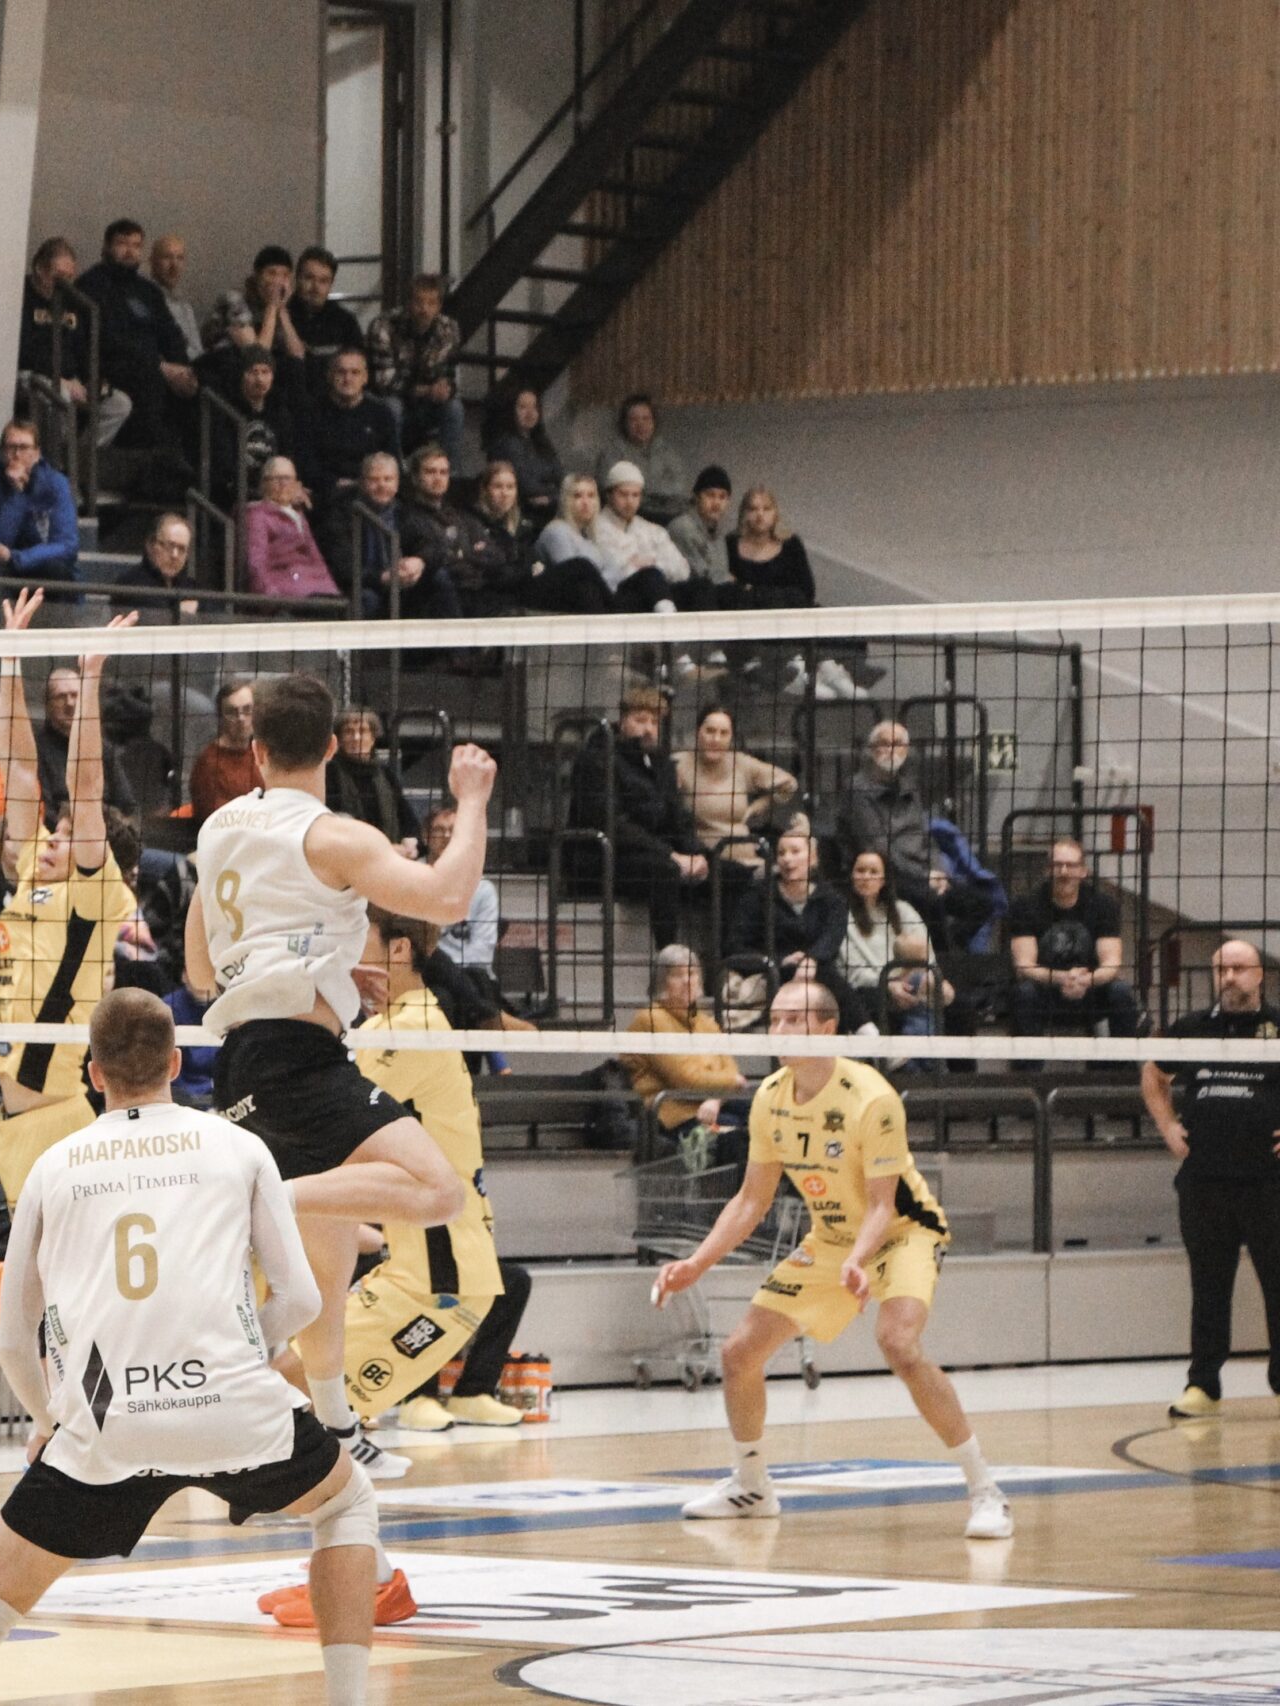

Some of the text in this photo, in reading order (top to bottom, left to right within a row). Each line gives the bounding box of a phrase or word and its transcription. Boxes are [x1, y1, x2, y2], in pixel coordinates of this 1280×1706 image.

[68, 1130, 200, 1169] HAAPAKOSKI
[797, 1132, 810, 1158] 7
[114, 1212, 159, 1302] 6
[124, 1358, 207, 1396] PKS
[361, 1363, 391, 1387] BE
[127, 1392, 222, 1414] Sähkökauppa
